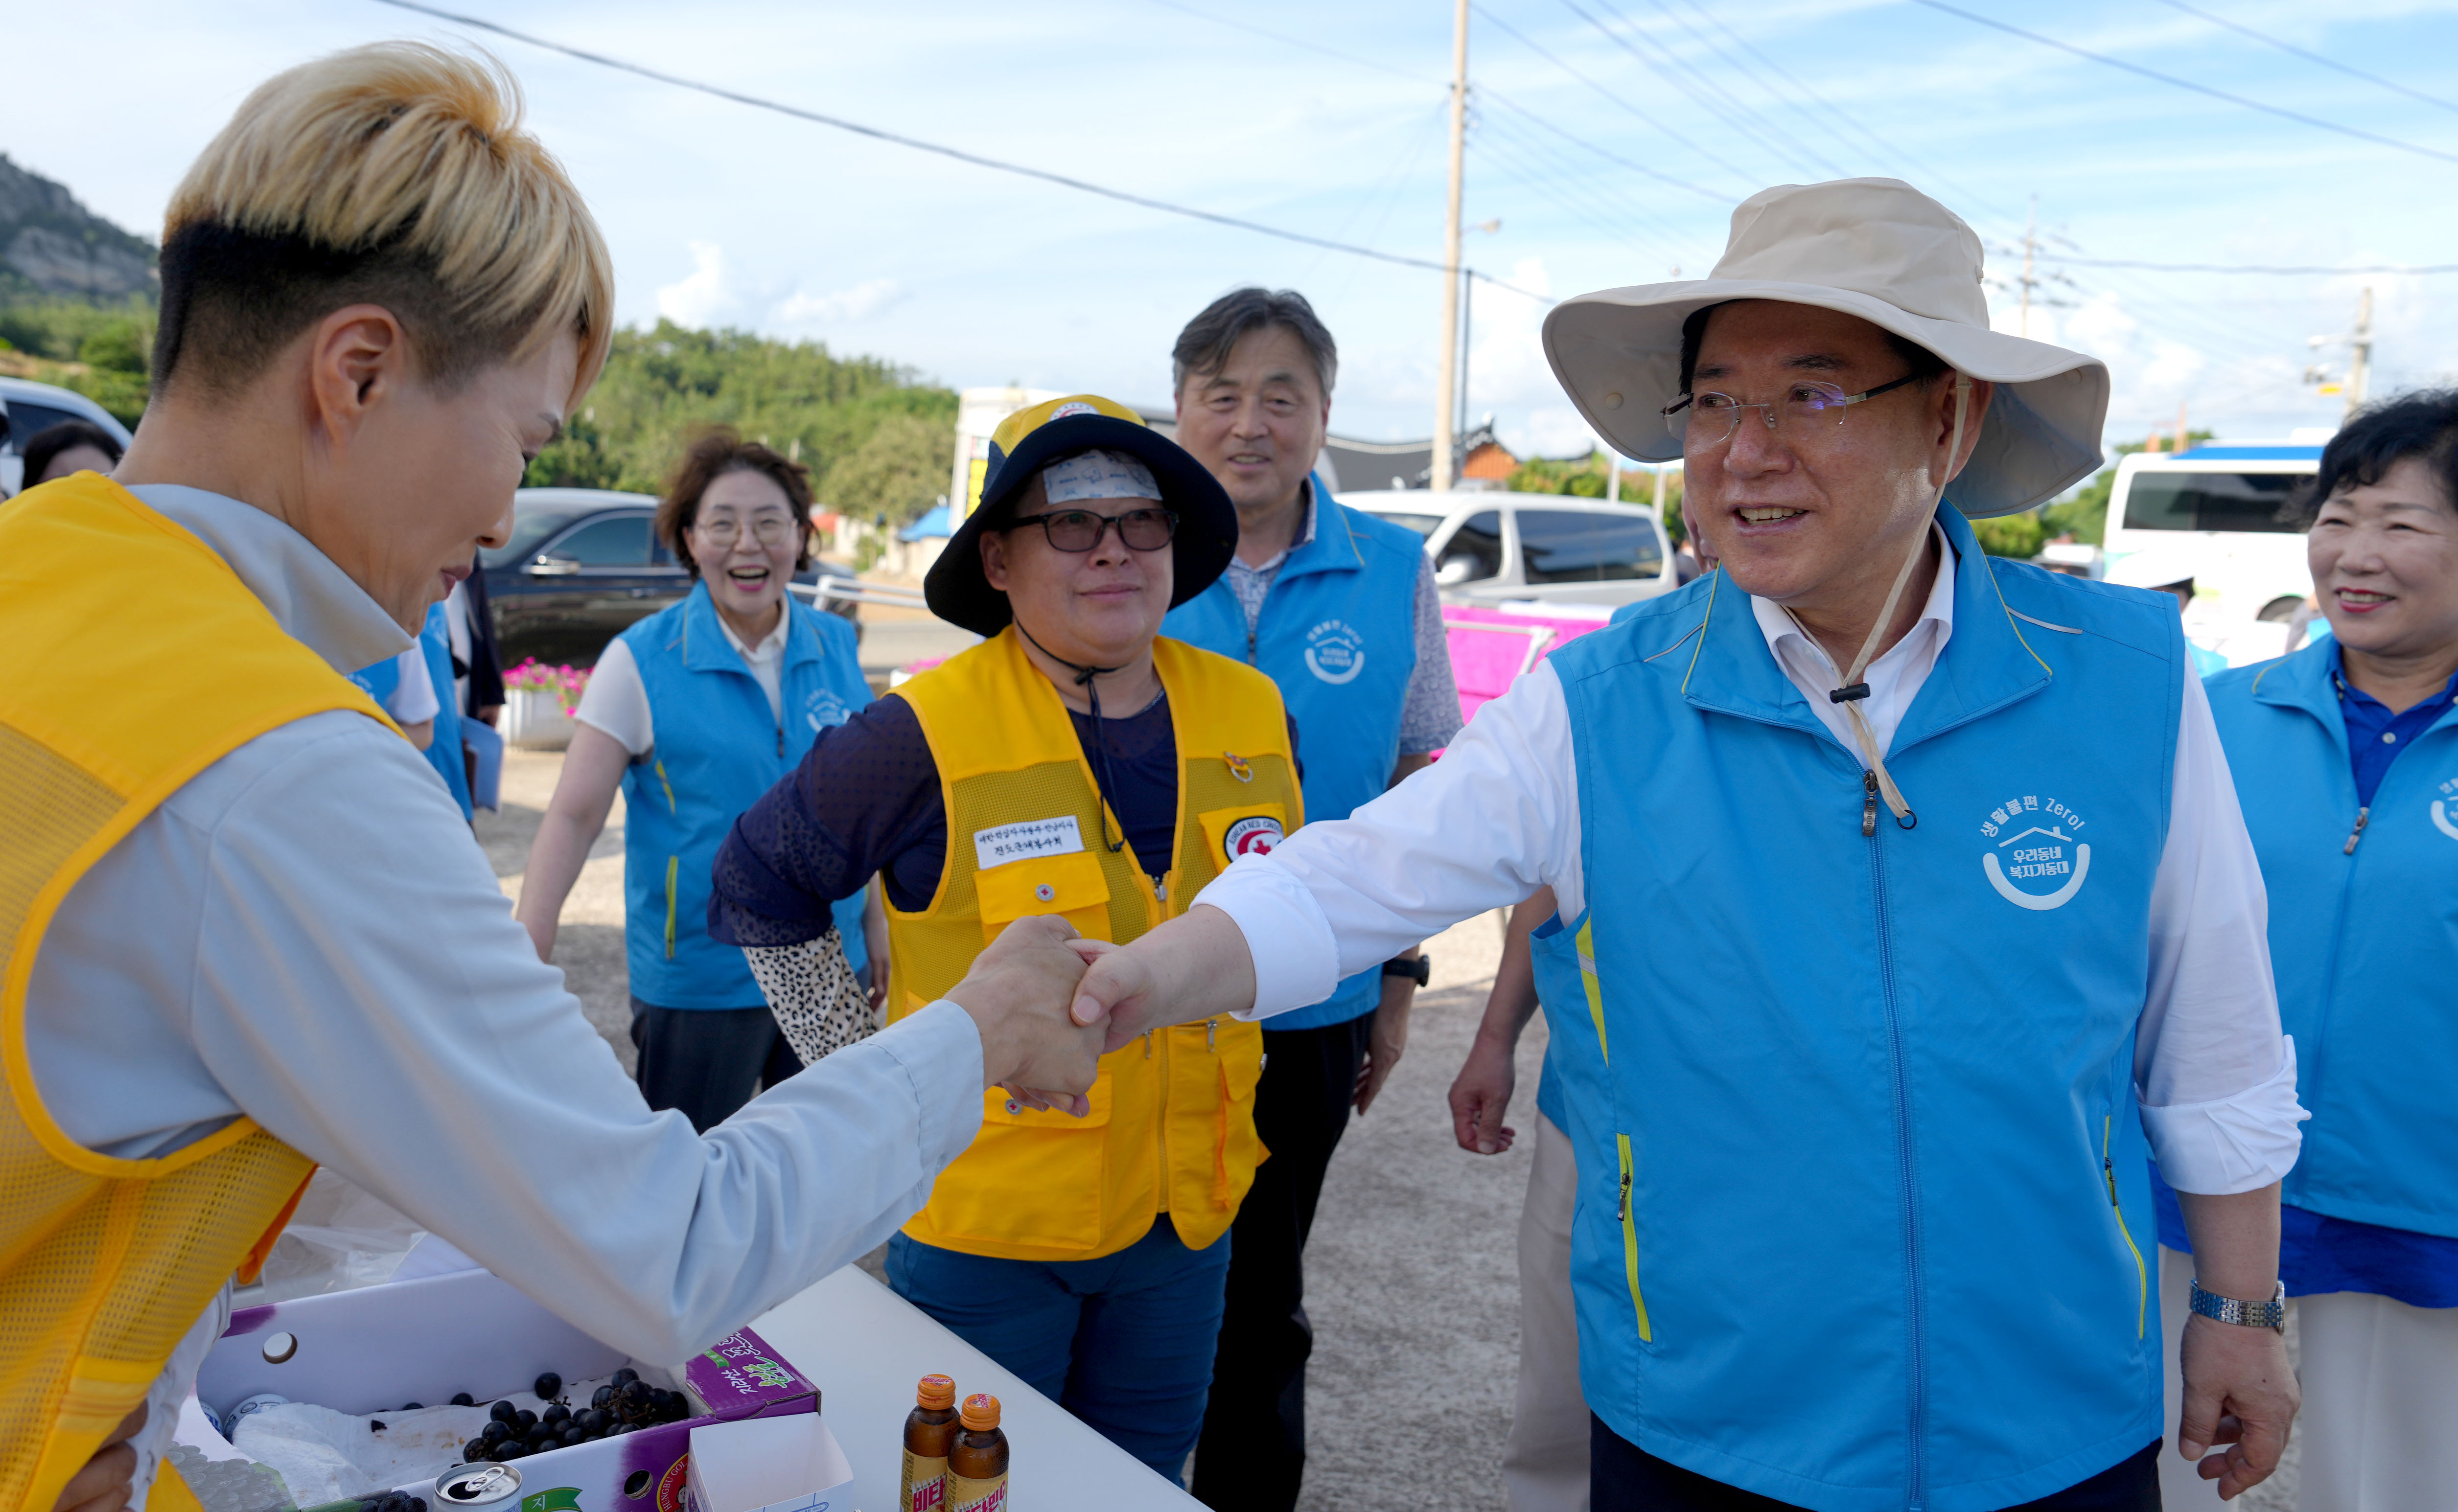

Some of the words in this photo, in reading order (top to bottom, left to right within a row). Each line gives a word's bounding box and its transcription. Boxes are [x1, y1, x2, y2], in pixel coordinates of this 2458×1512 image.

[1980, 795, 2039, 838] 생활불편
[2045, 798, 2086, 830] Zero!
[2013, 846, 2062, 863] 우리동네
[2009, 861, 2069, 879] 복지기동대
[721, 1369, 758, 1394] 지리산
[661, 1476, 673, 1512] HUNGBU
